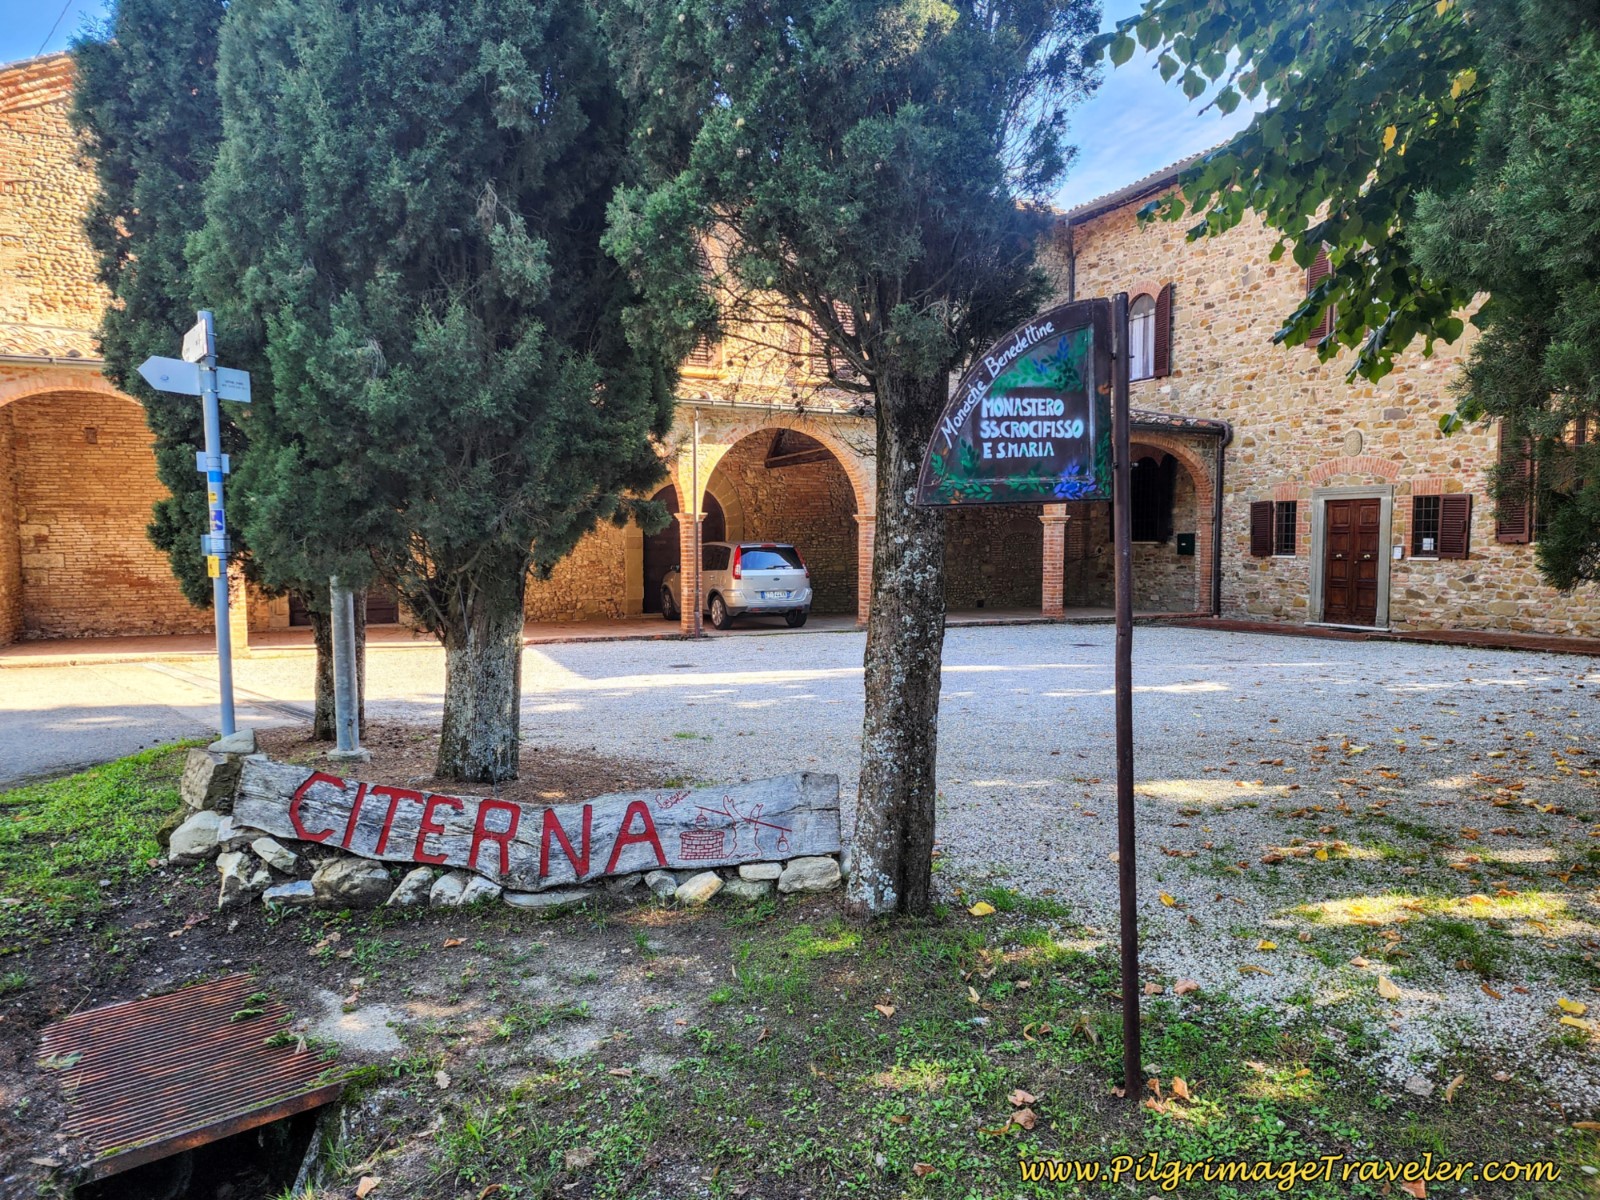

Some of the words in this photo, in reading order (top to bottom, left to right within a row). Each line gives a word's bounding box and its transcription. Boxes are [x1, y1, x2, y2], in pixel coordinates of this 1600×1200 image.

[985, 321, 1055, 378] Benedettine
[980, 398, 1064, 417] MONASTERO
[983, 443, 992, 459] E
[996, 442, 1054, 459] S.MARIA
[289, 771, 668, 877] CITERNA
